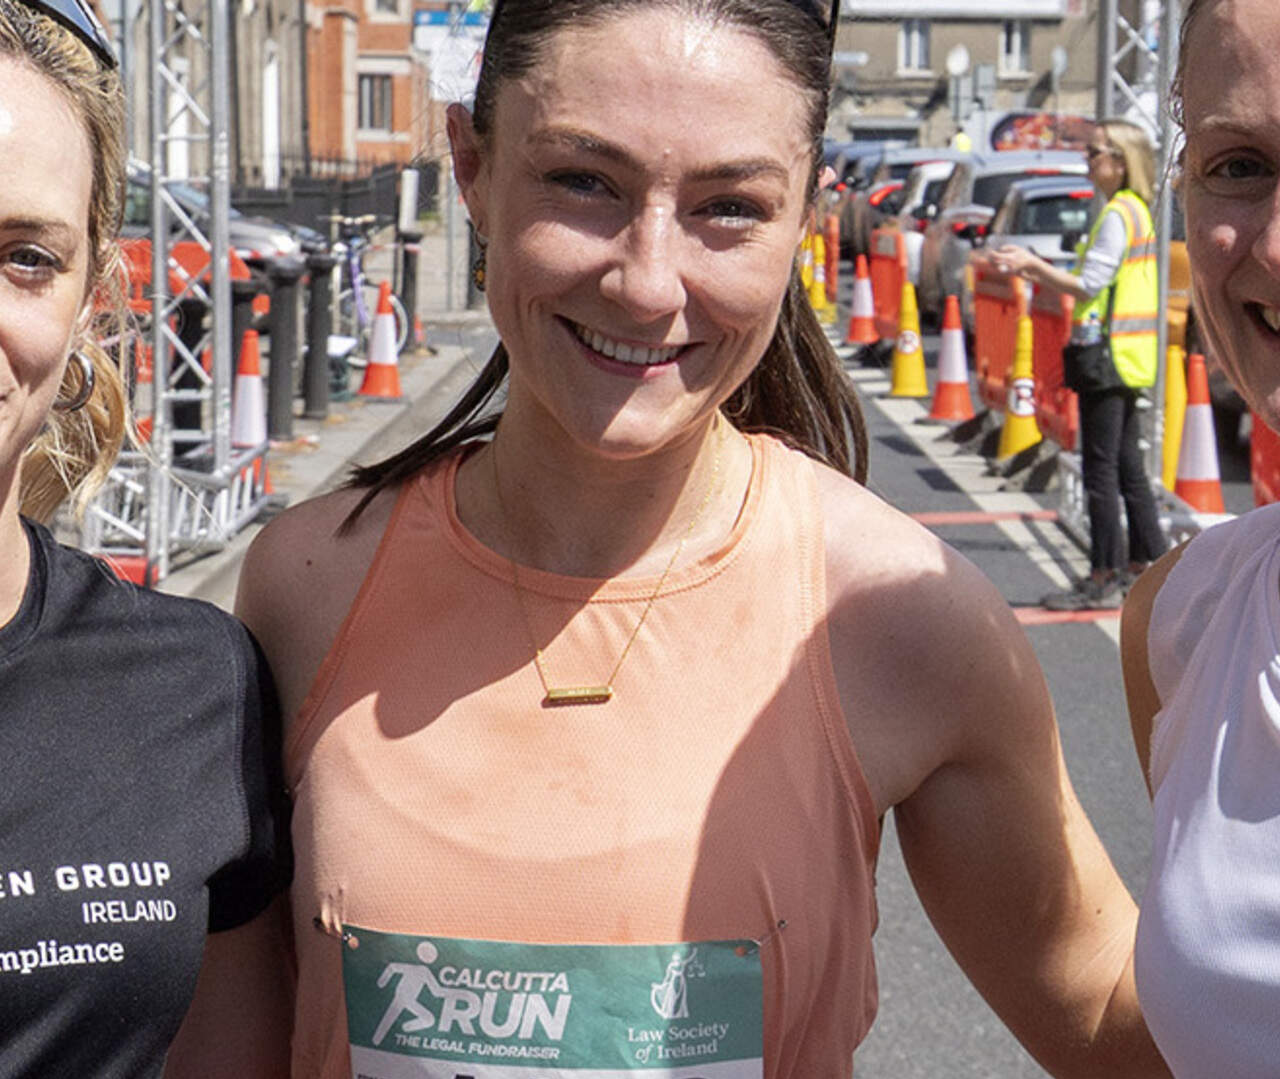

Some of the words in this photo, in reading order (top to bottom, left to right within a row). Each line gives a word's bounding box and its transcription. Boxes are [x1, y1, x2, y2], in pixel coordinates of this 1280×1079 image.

[55, 861, 171, 891] GROUP
[82, 900, 176, 923] IRELAND
[439, 967, 570, 993] CALCUTTA
[437, 988, 572, 1041] RUN
[627, 1026, 664, 1044] Law
[668, 1020, 730, 1043] Society
[395, 1034, 421, 1049] THE
[422, 1037, 465, 1056] LEGAL
[468, 1042, 560, 1061] FUNDRAISER
[634, 1045, 653, 1064] of
[657, 1039, 718, 1060] Ireland
